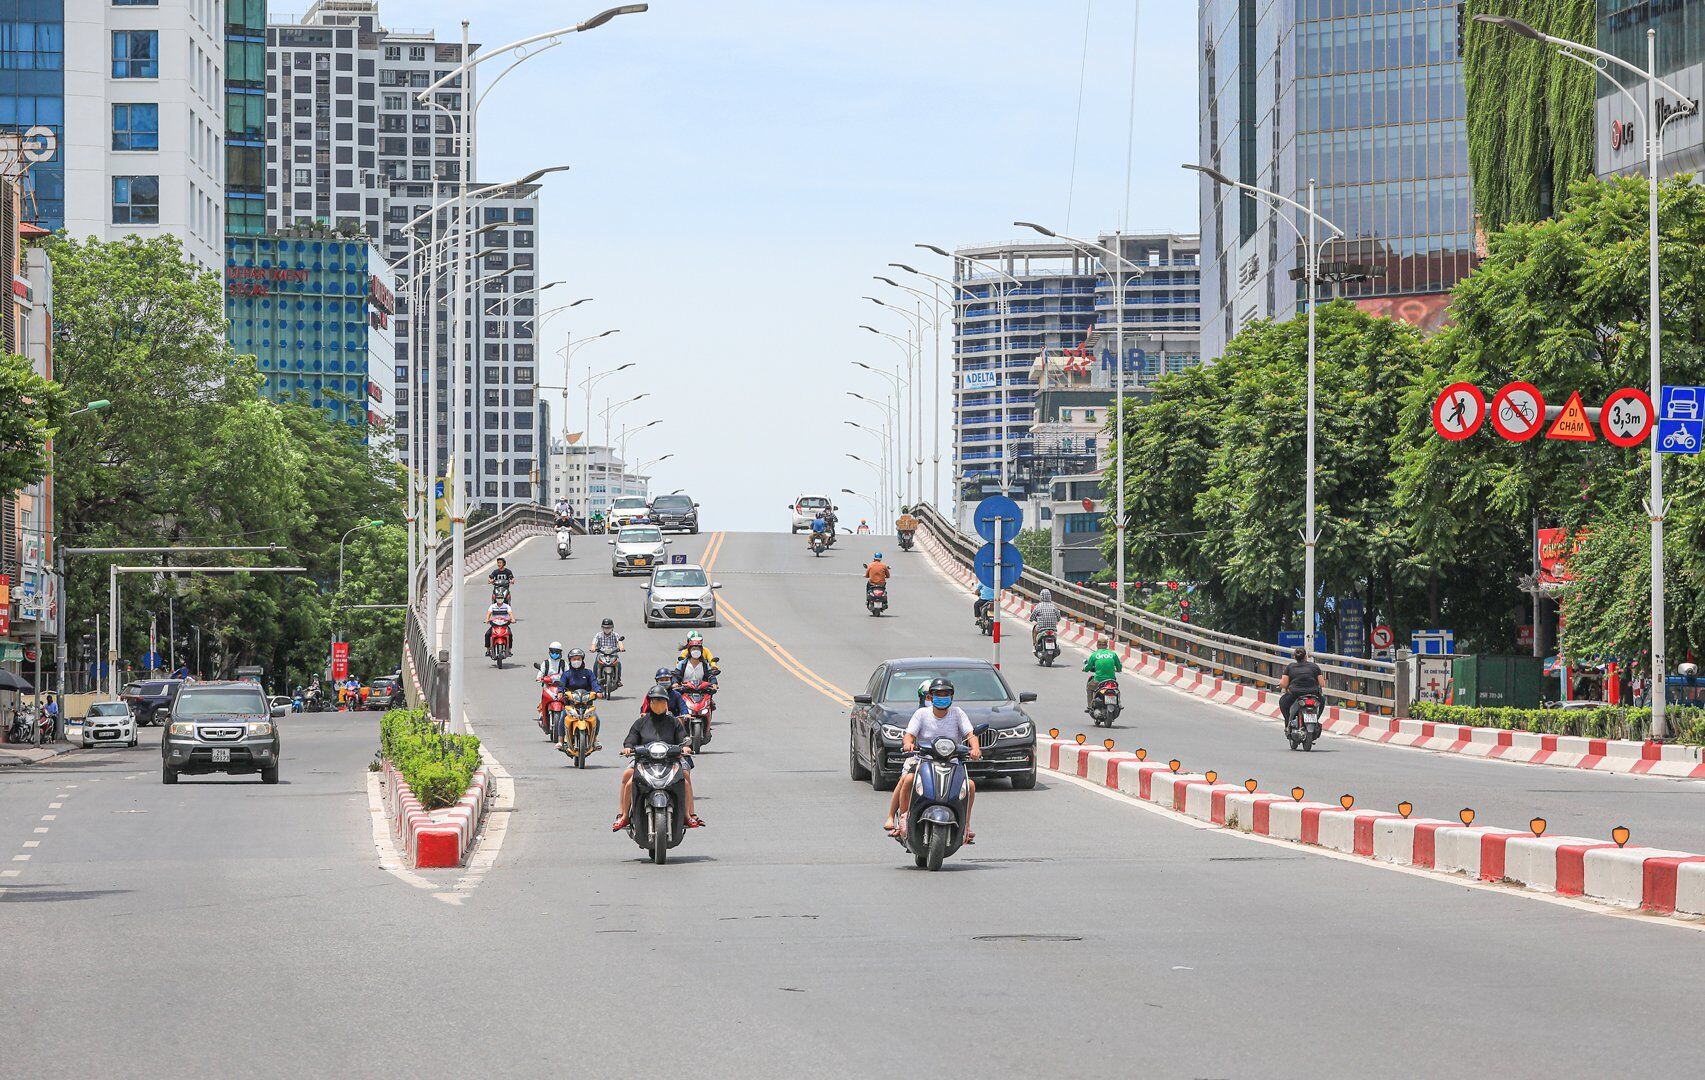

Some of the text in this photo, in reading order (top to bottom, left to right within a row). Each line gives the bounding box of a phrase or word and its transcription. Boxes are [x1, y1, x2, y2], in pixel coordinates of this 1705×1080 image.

[1622, 121, 1634, 146] LG
[972, 371, 995, 383] DELTA
[1560, 419, 1584, 433] CHẬM
[1613, 406, 1641, 429] 3,3m
